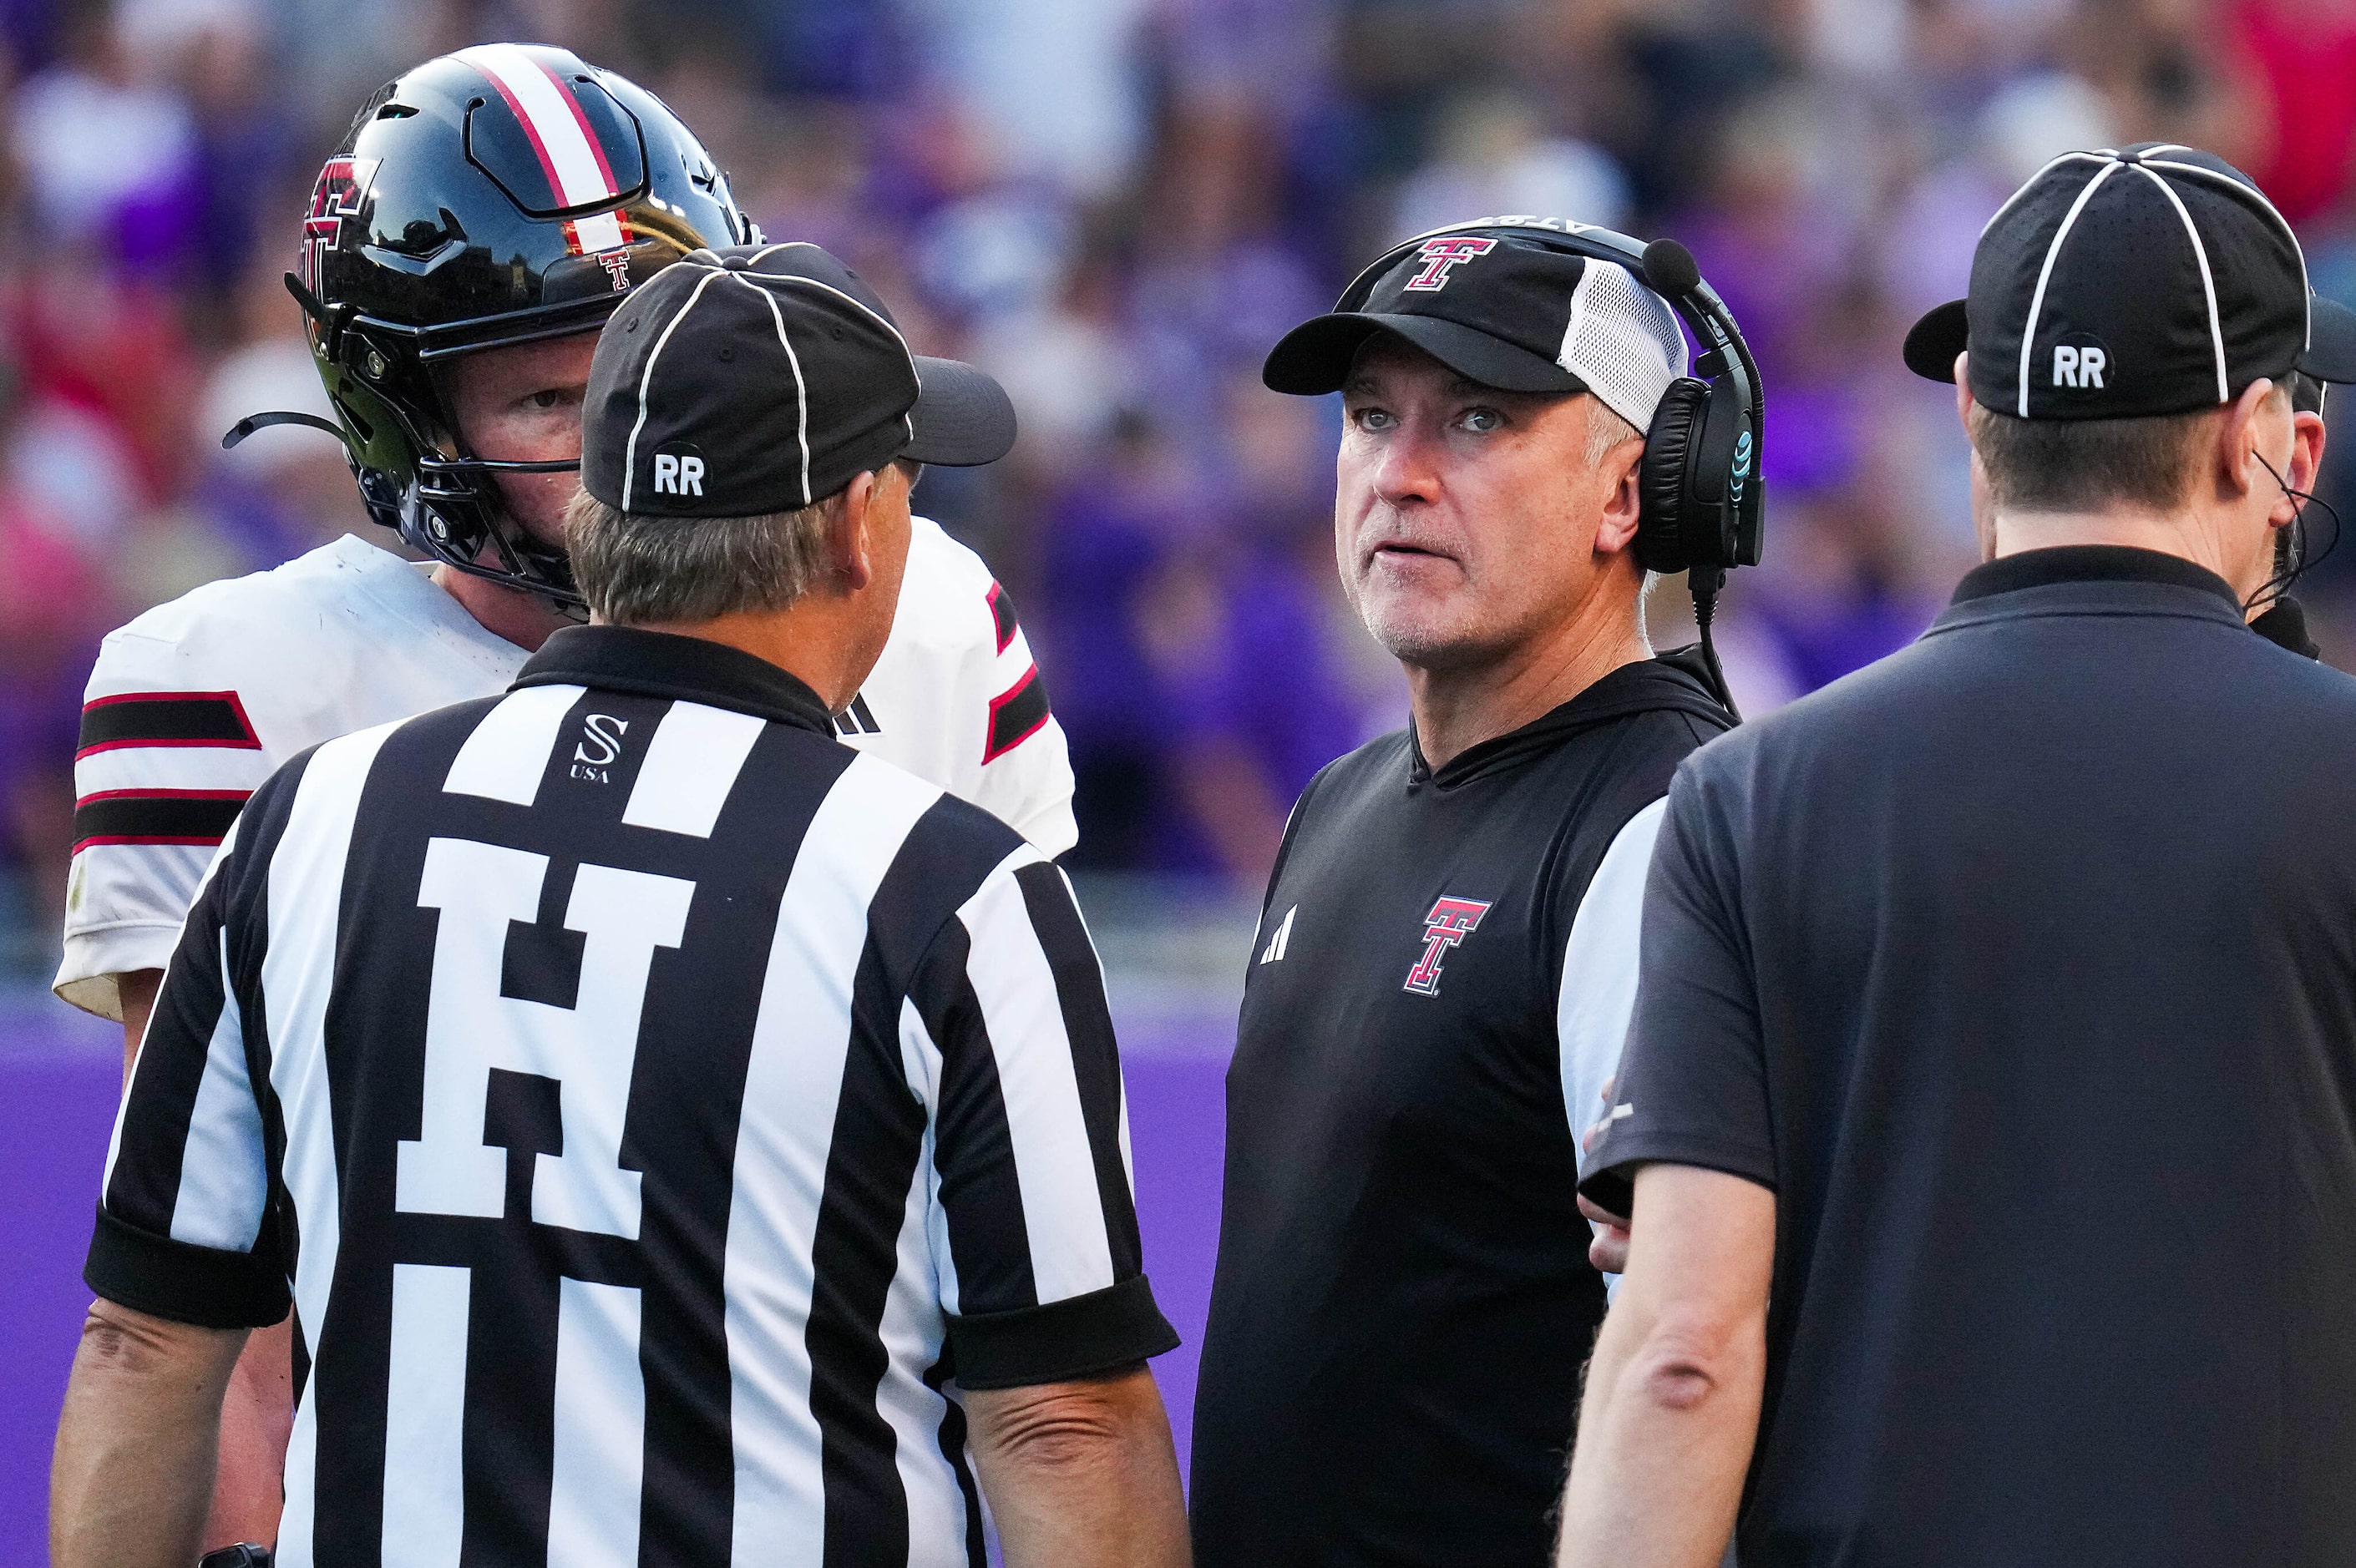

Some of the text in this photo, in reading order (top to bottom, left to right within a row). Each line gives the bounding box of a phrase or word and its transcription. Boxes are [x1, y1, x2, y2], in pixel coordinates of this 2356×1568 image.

[2053, 345, 2106, 389] RR
[654, 453, 705, 497] RR
[570, 764, 609, 784] USA
[395, 837, 697, 1241] H
